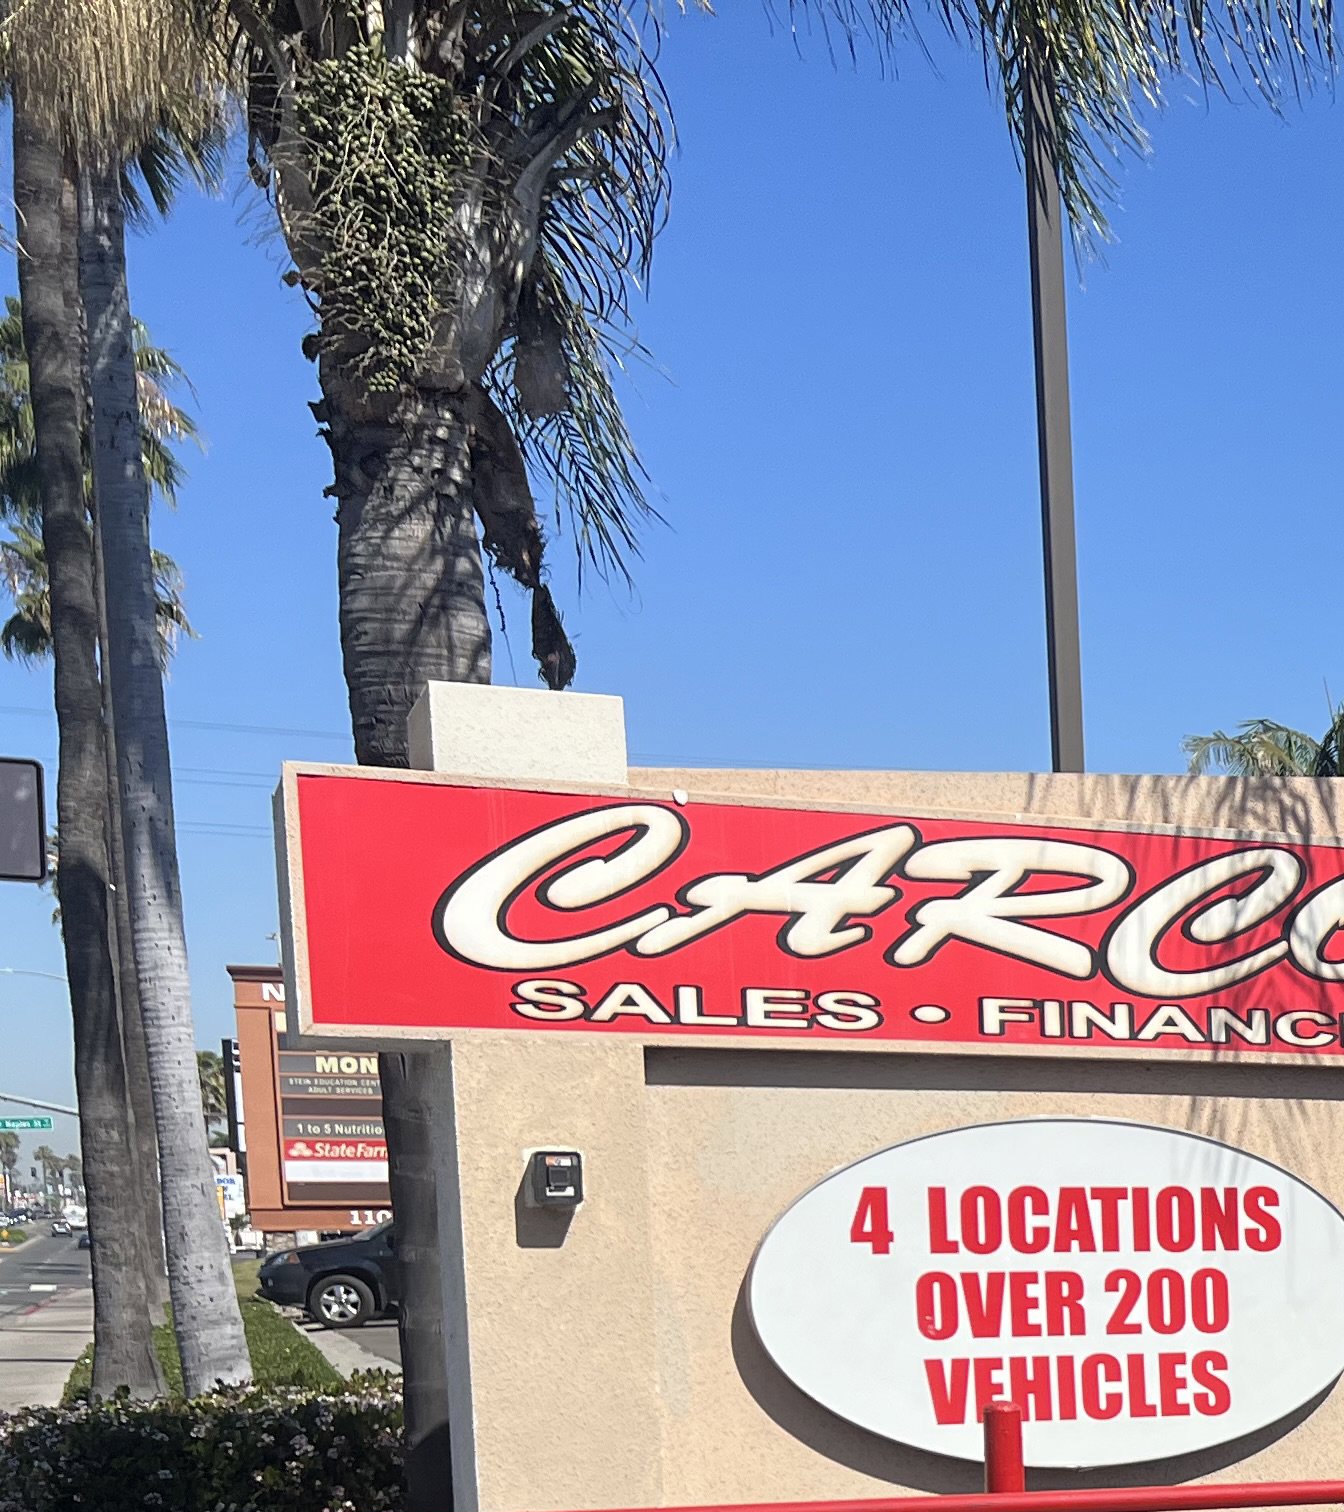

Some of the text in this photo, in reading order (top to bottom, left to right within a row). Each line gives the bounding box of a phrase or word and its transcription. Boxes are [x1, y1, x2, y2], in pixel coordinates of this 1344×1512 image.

[511, 978, 881, 1032] SALES
[308, 1086, 373, 1095] ADULT SERVICES
[314, 1078, 358, 1087] EDUCATION
[297, 1123, 302, 1134] 1
[307, 1123, 321, 1135] to
[850, 1185, 1282, 1254] 4 LOCATIONS
[915, 1268, 1230, 1341] OVER 200
[923, 1350, 1232, 1425] VEHICLES
